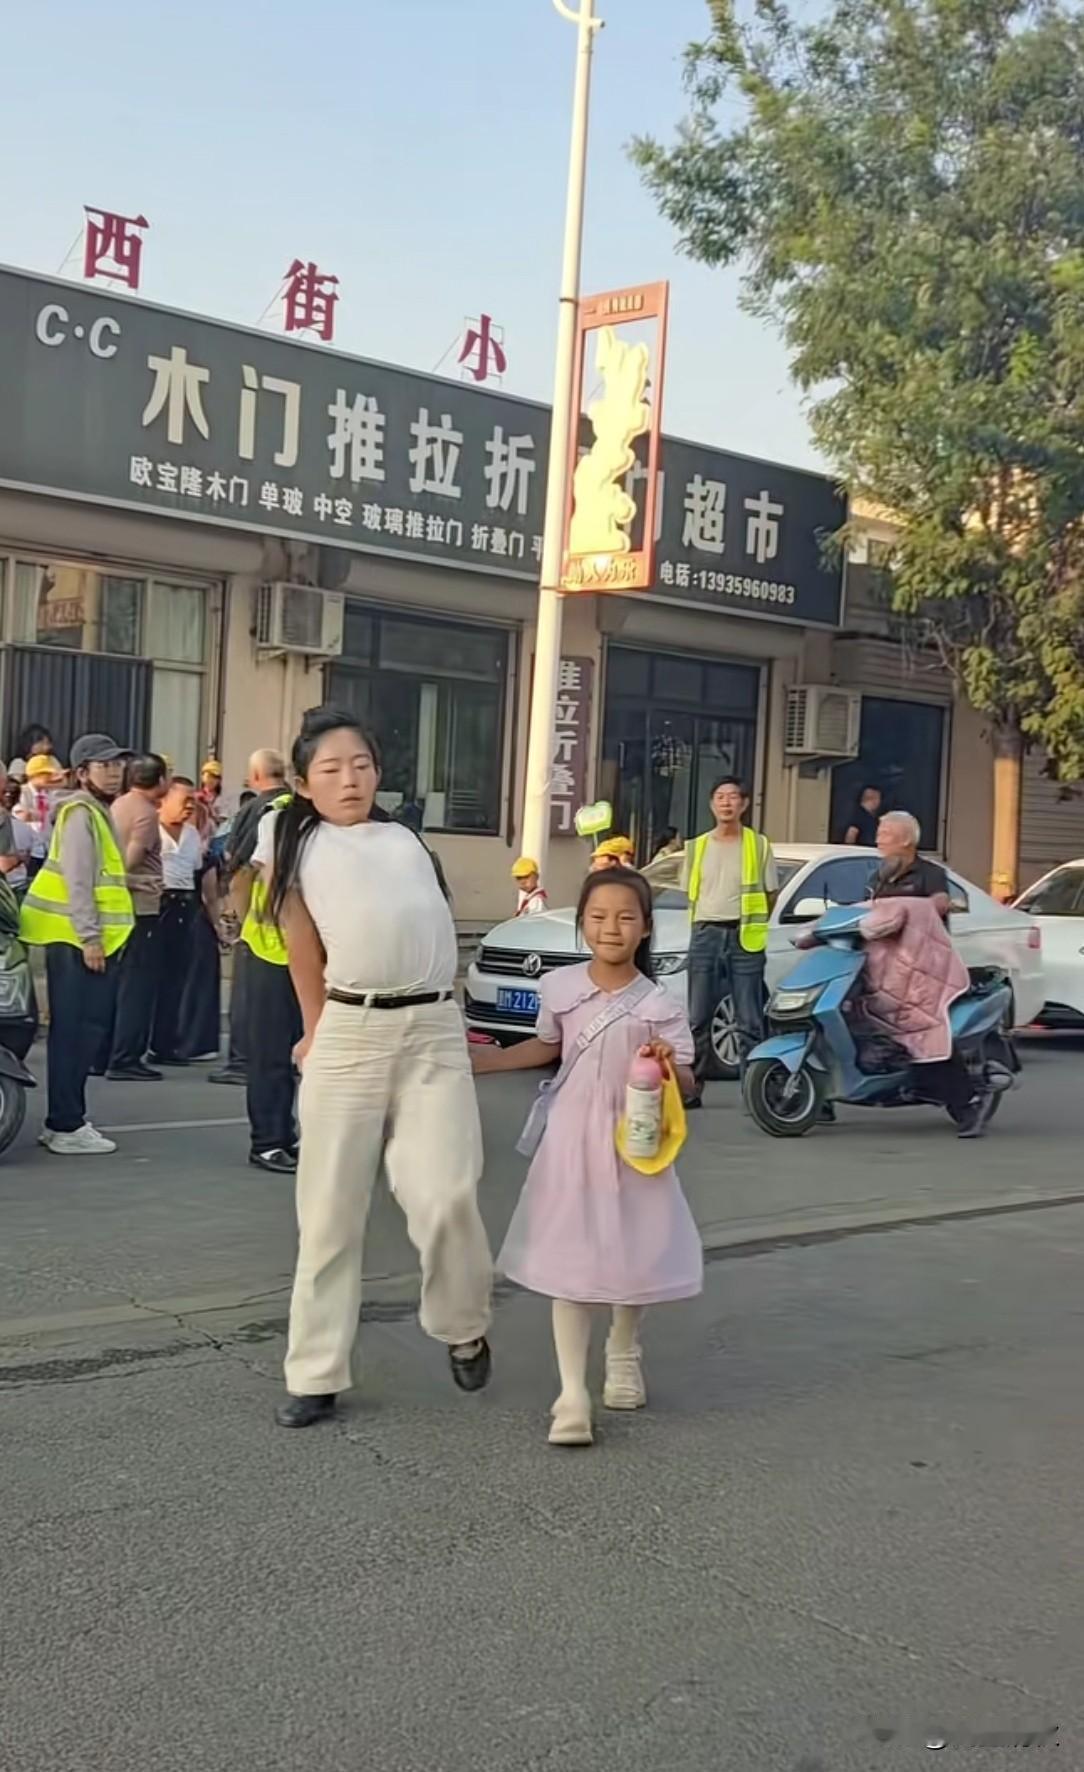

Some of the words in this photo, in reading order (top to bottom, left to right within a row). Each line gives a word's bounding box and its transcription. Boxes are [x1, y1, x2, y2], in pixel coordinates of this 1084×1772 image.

[130, 456, 248, 506] 欧宝隆木门
[259, 481, 303, 516] 单玻
[313, 493, 353, 526] 中空
[362, 503, 463, 547] 玻璃推拉门
[471, 523, 525, 558] 折叠门
